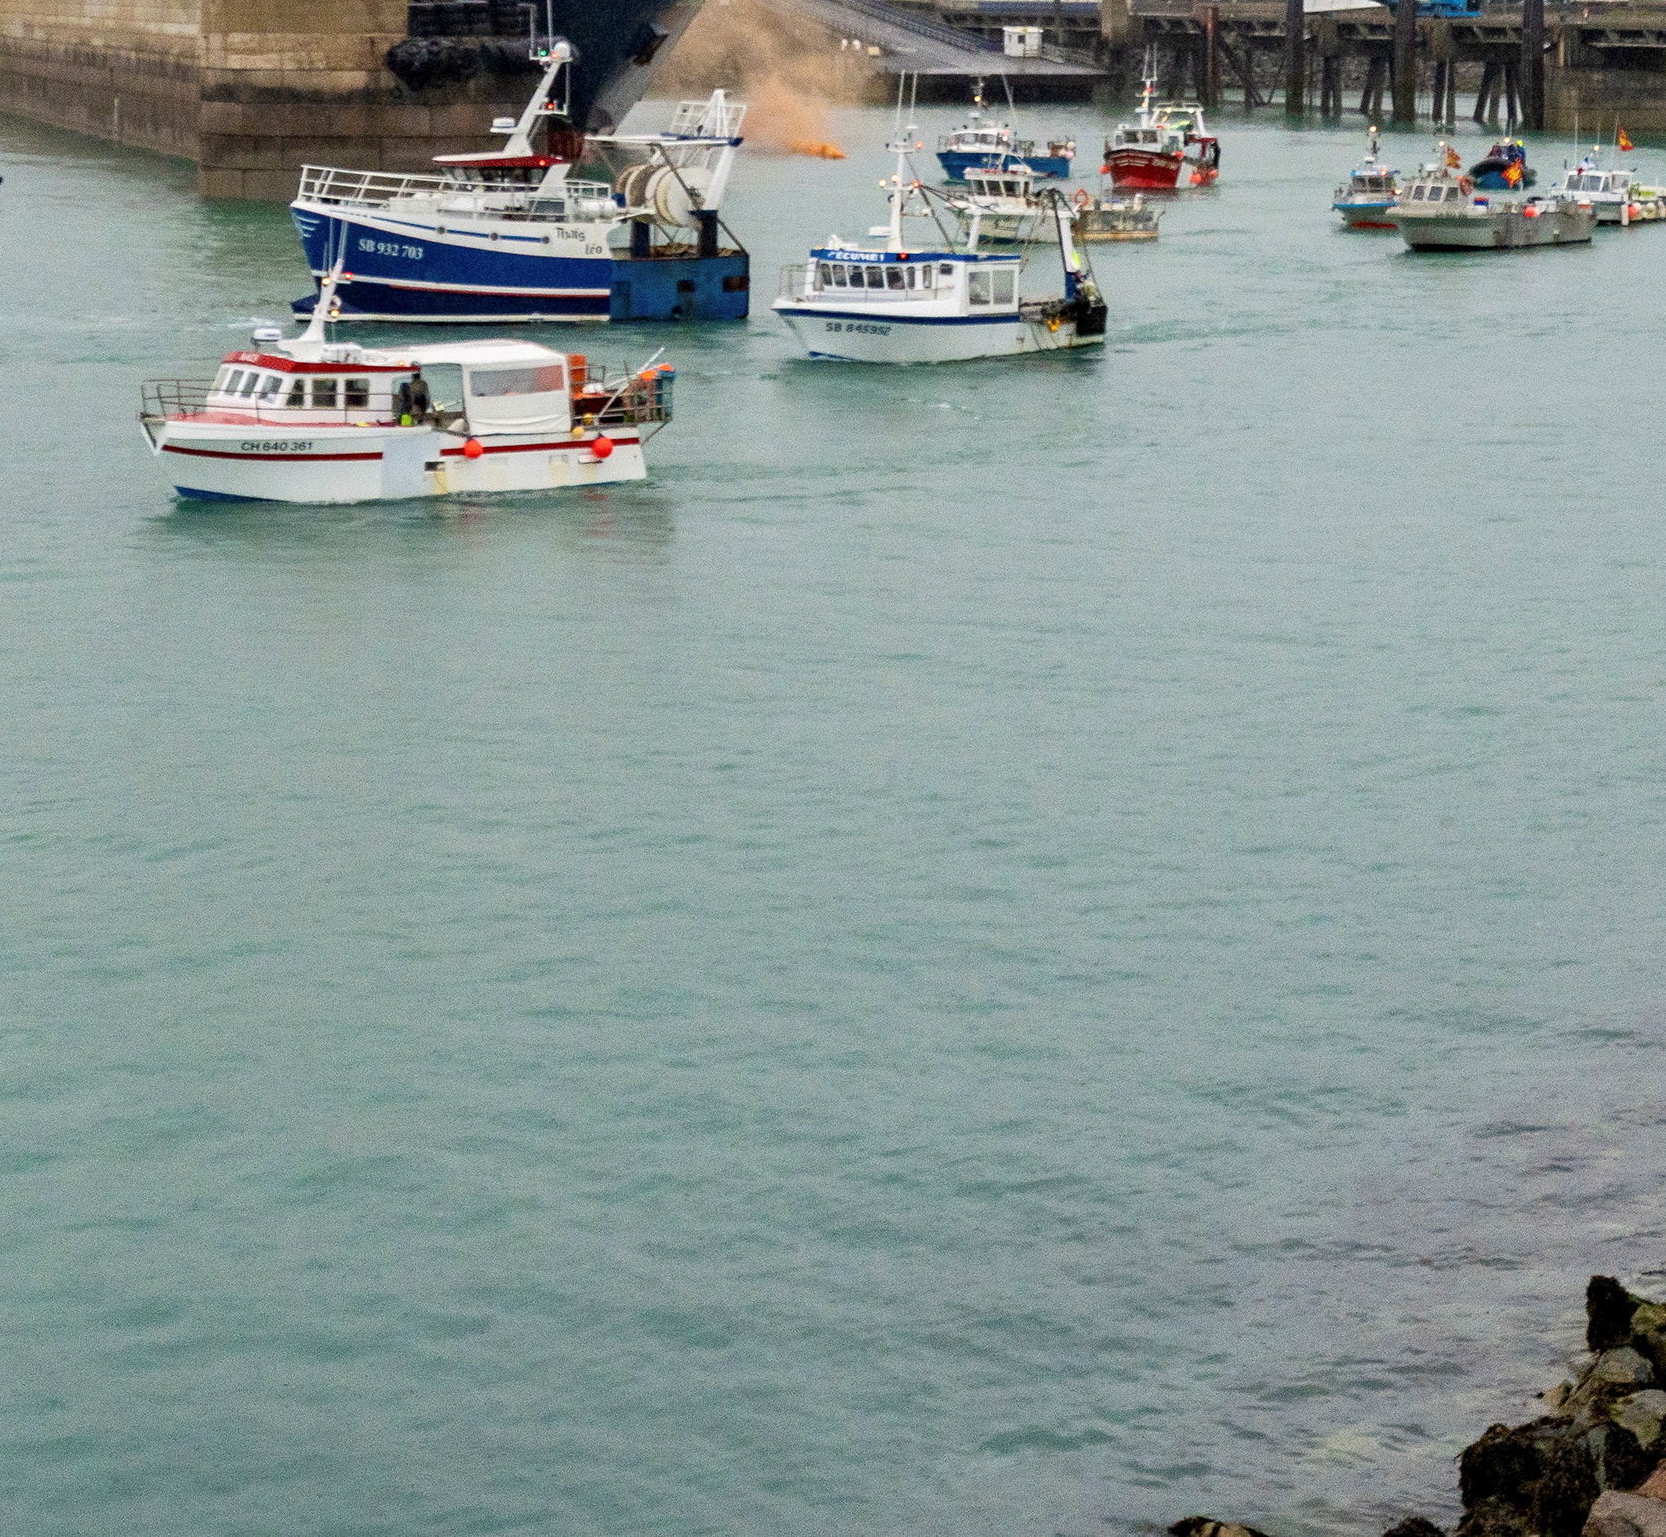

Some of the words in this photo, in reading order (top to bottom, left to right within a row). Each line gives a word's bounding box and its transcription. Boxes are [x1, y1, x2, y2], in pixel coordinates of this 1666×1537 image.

[358, 238, 375, 252] SB
[376, 242, 400, 256] 932
[401, 245, 423, 260] 703
[826, 322, 842, 332] SB
